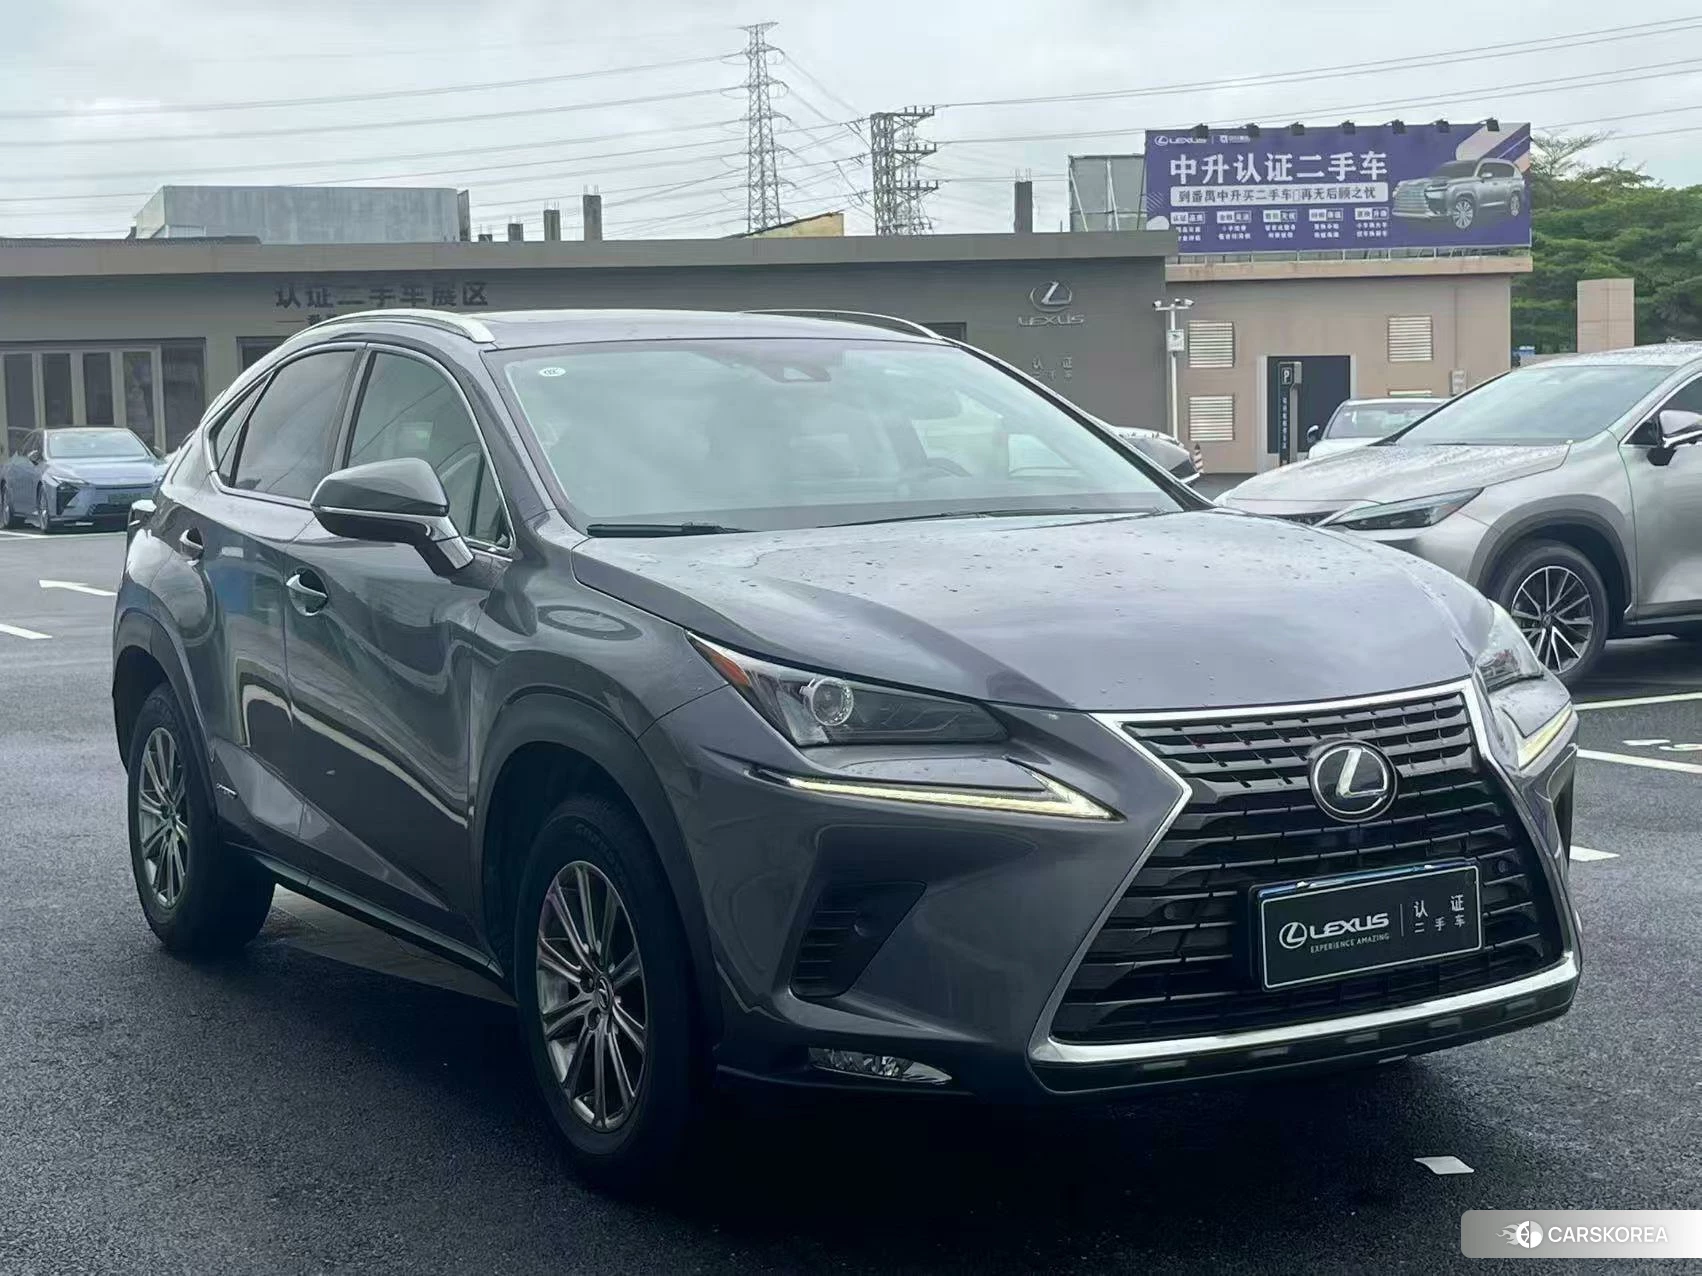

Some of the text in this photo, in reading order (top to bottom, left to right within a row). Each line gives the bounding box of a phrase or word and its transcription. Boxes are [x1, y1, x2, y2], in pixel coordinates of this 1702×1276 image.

[1170, 150, 1388, 185] 中升认证二手车
[1018, 314, 1085, 326] LEXUS
[1283, 369, 1290, 383] P
[1414, 894, 1465, 918] 认证
[1309, 912, 1390, 940] LEXUS
[1414, 914, 1466, 934] 二手车
[1310, 932, 1390, 954] EXPERIENCE AMAZING
